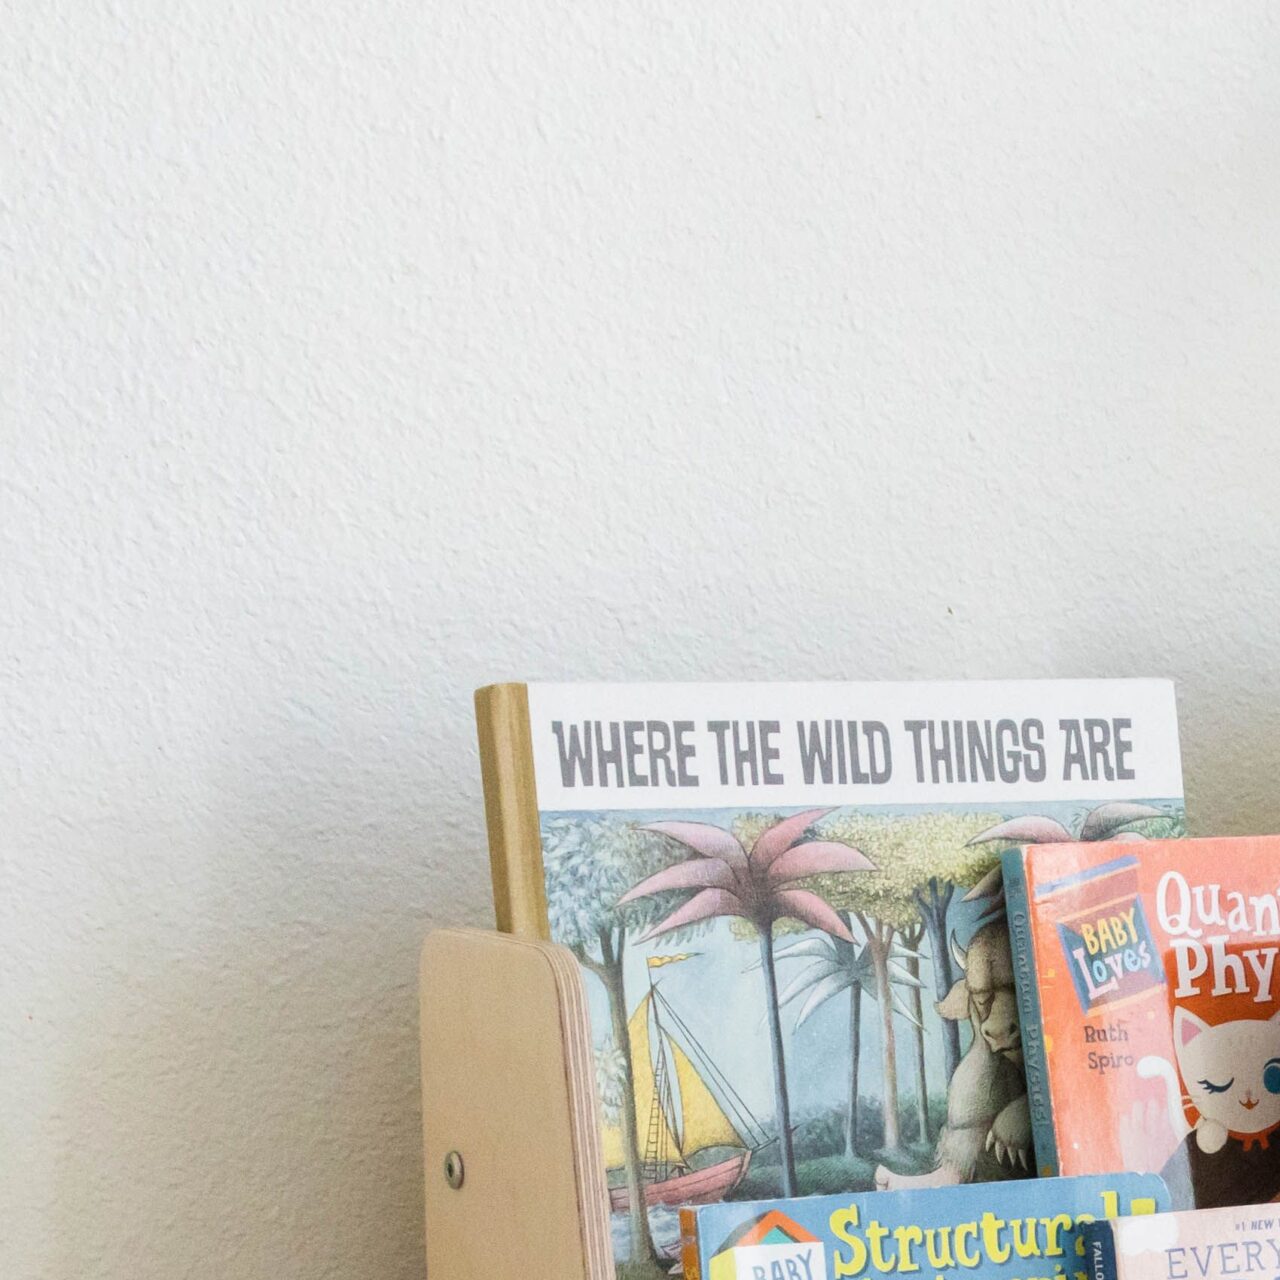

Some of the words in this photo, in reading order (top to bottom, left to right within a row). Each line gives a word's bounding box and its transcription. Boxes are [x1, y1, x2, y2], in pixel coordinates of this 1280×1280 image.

[551, 720, 699, 788] WHERE
[707, 720, 784, 787] THE
[797, 719, 892, 785] WILD
[904, 718, 1047, 784] THINGS
[1059, 718, 1136, 782] ARE
[1081, 907, 1139, 955] BABY
[1073, 940, 1152, 1000] Loves
[1084, 1024, 1129, 1043] Ruth
[1088, 1051, 1134, 1075] Spiro
[1251, 1218, 1274, 1231] NEW
